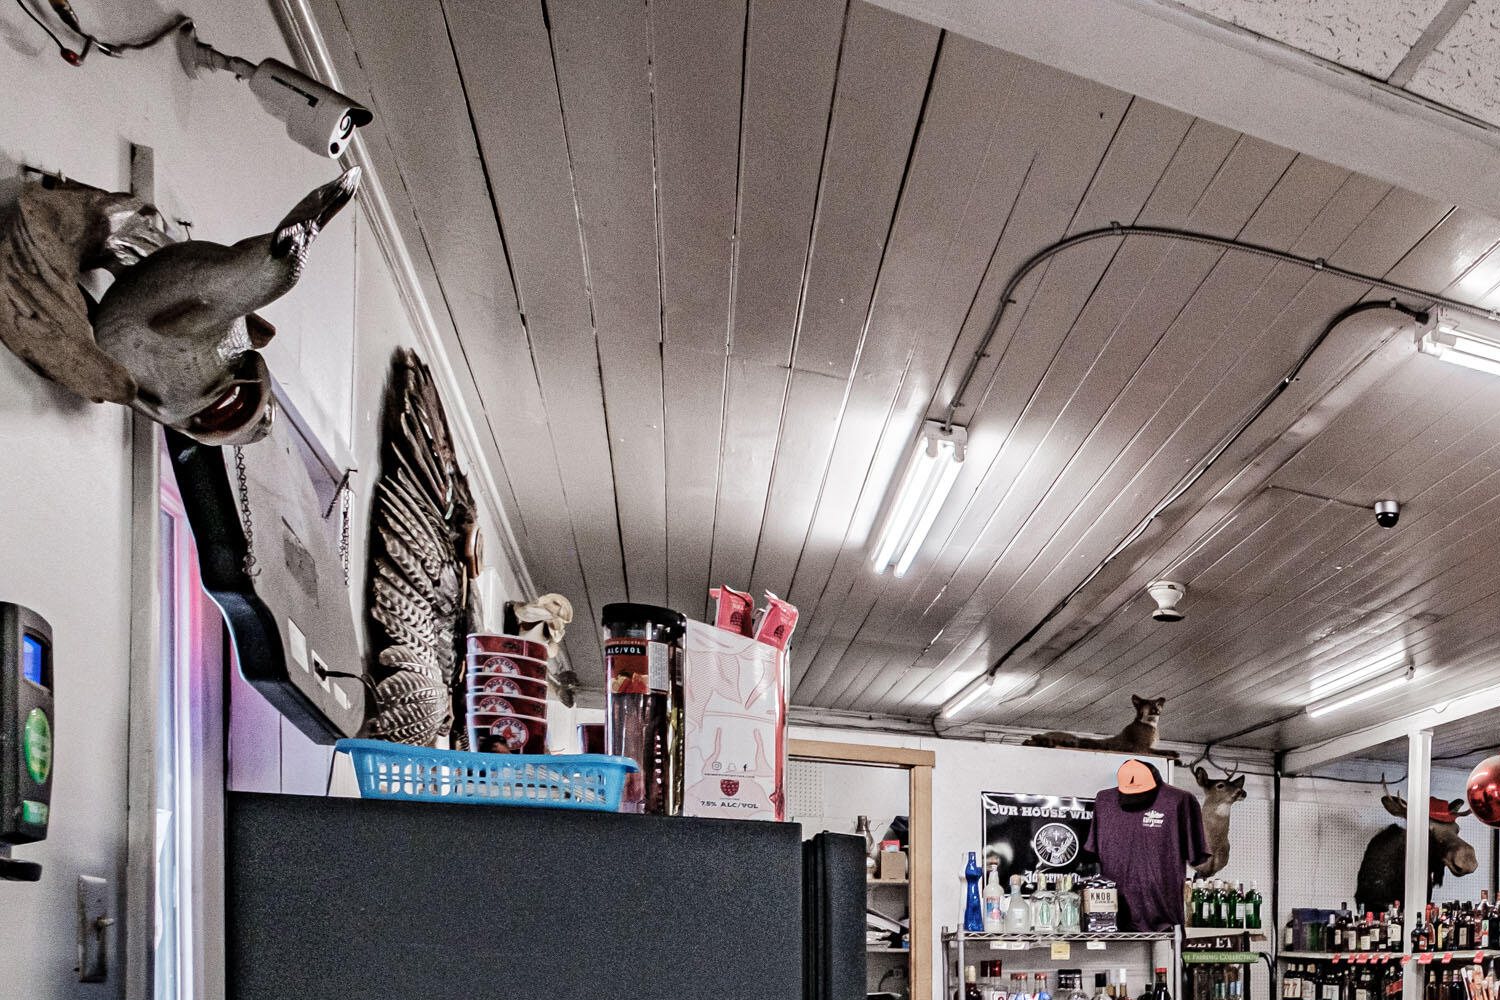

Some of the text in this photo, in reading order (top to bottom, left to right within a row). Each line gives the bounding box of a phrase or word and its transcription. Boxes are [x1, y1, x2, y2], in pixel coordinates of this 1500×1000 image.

[720, 801, 759, 809] ALC/VOL
[989, 804, 1019, 816] OUR
[1021, 806, 1068, 819] HOUSE
[1090, 891, 1111, 901] KNOB
